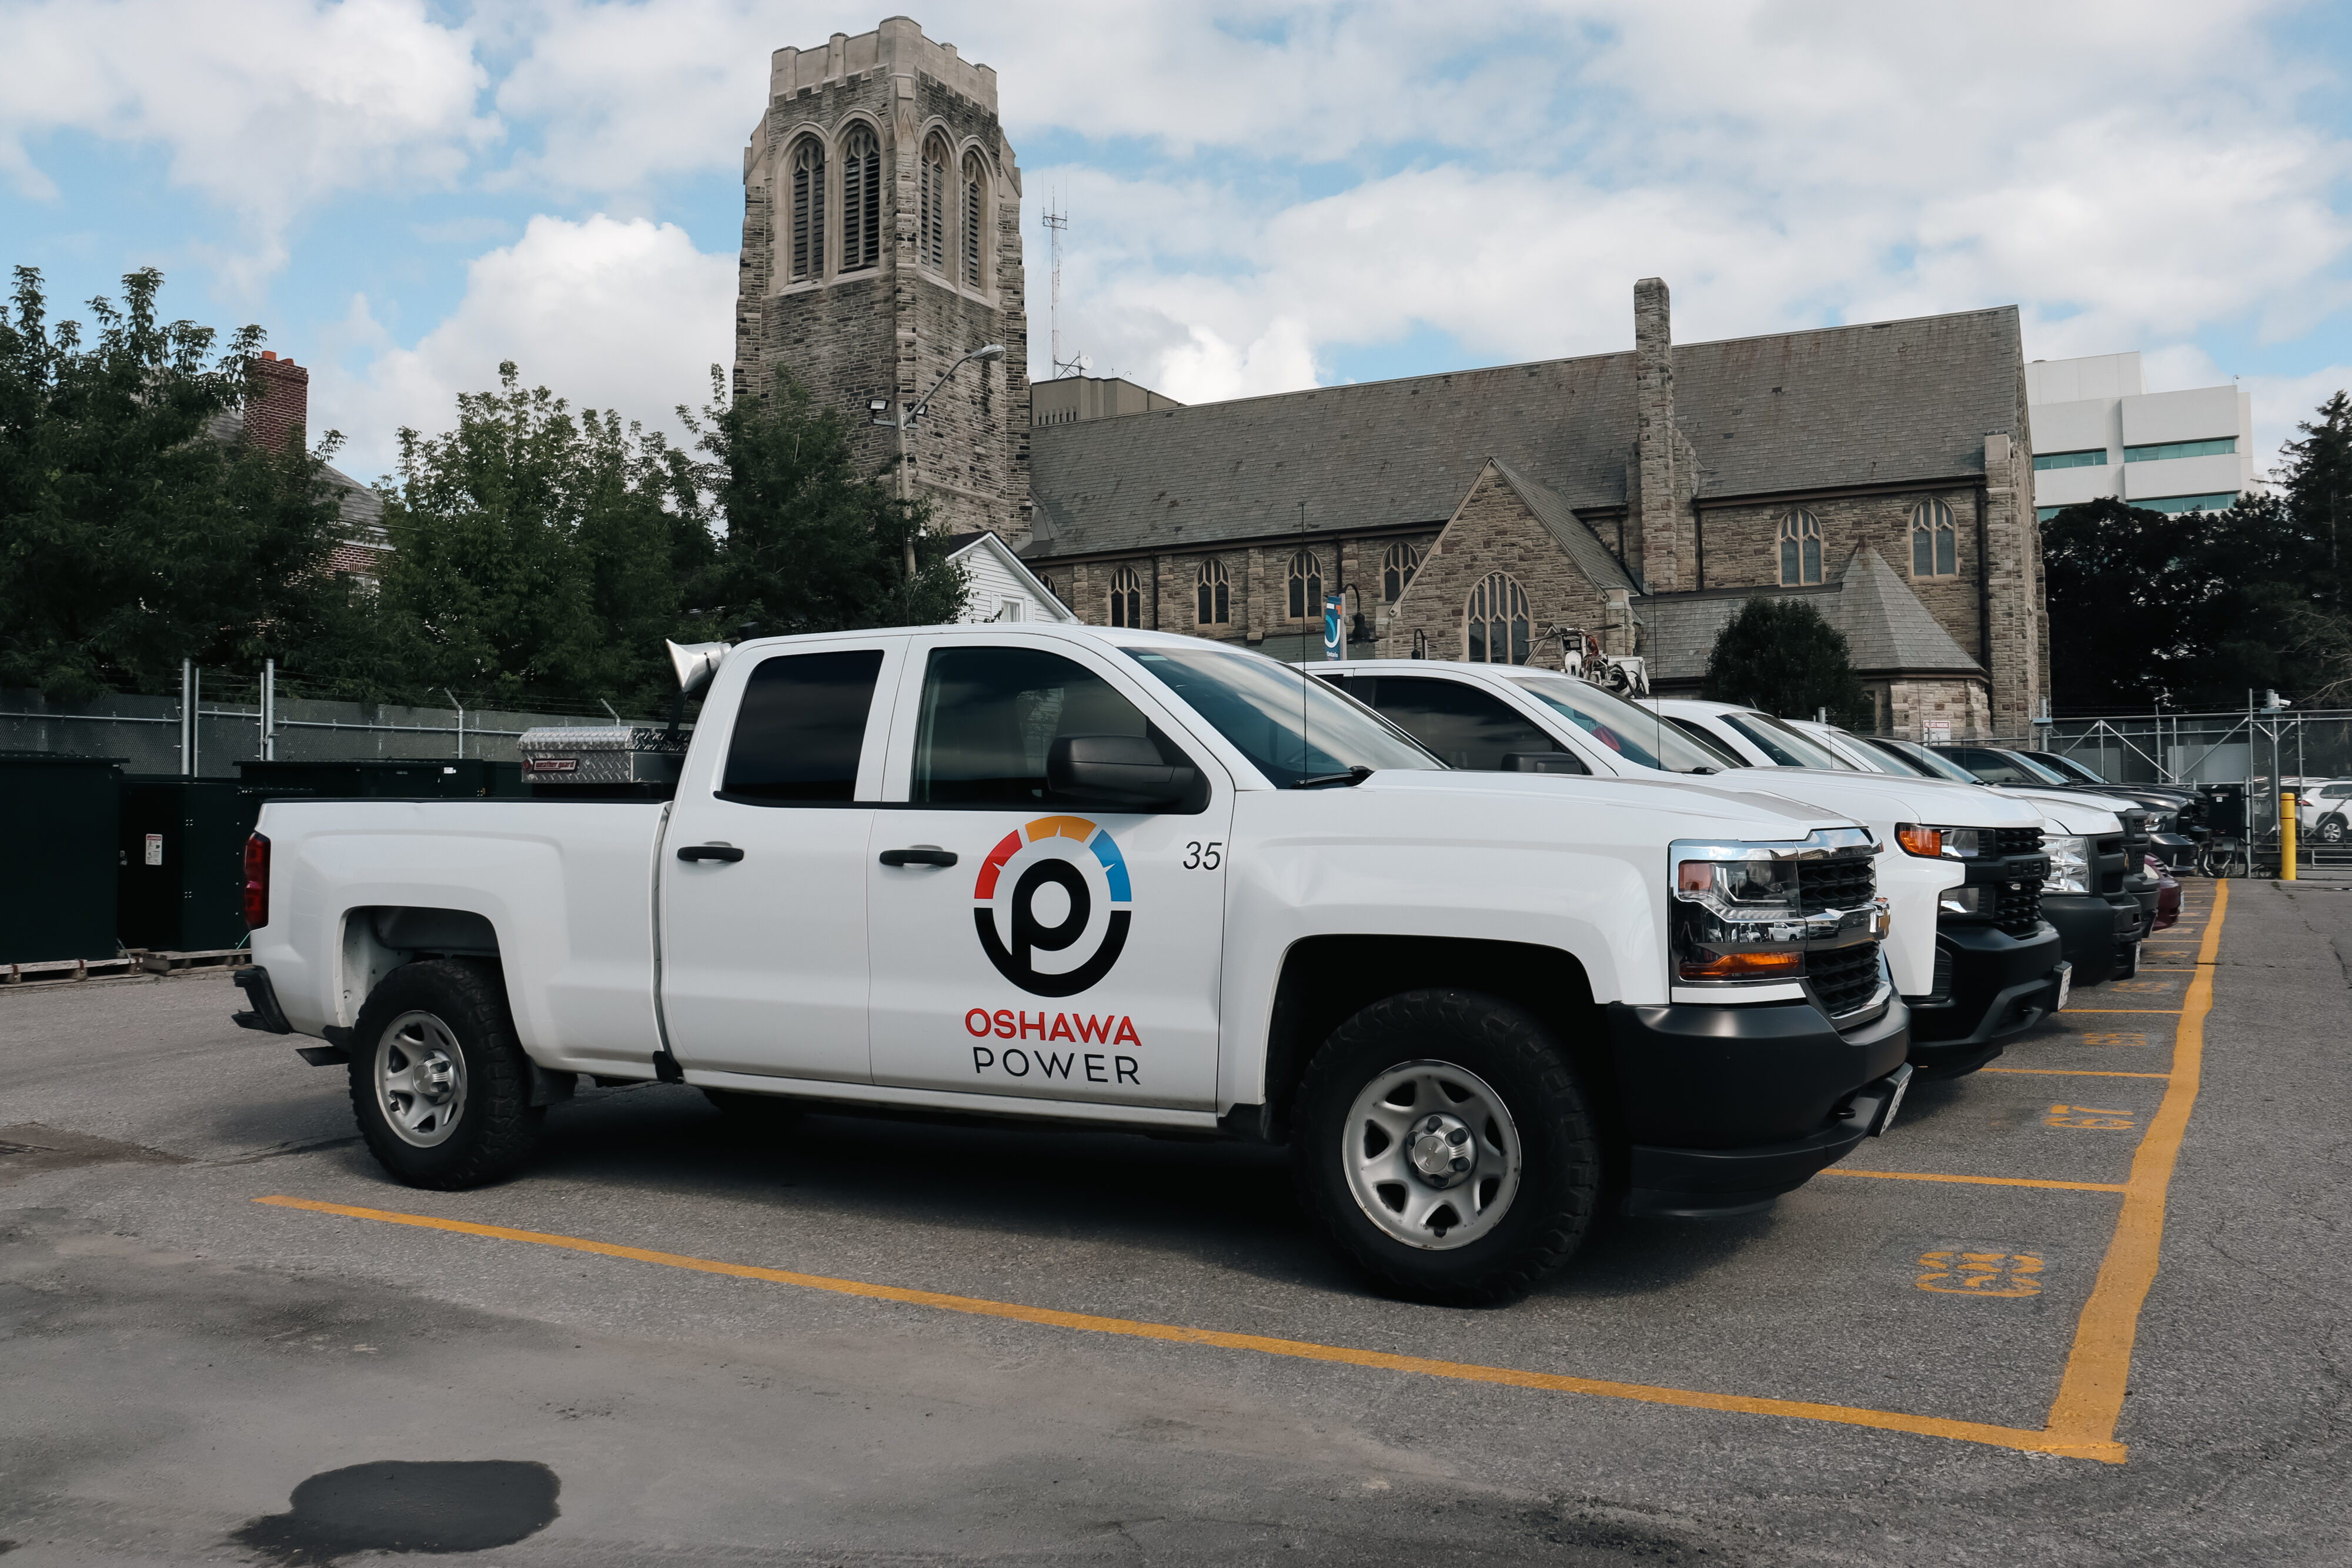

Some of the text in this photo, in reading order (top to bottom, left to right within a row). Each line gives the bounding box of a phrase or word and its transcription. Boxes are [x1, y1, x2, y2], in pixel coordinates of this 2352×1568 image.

[1183, 841, 1222, 870] 35
[965, 1008, 1141, 1046] OSHAWA
[973, 1047, 1141, 1085] POWER
[2044, 1104, 2136, 1130] 67
[1916, 1251, 2044, 1298] 68
